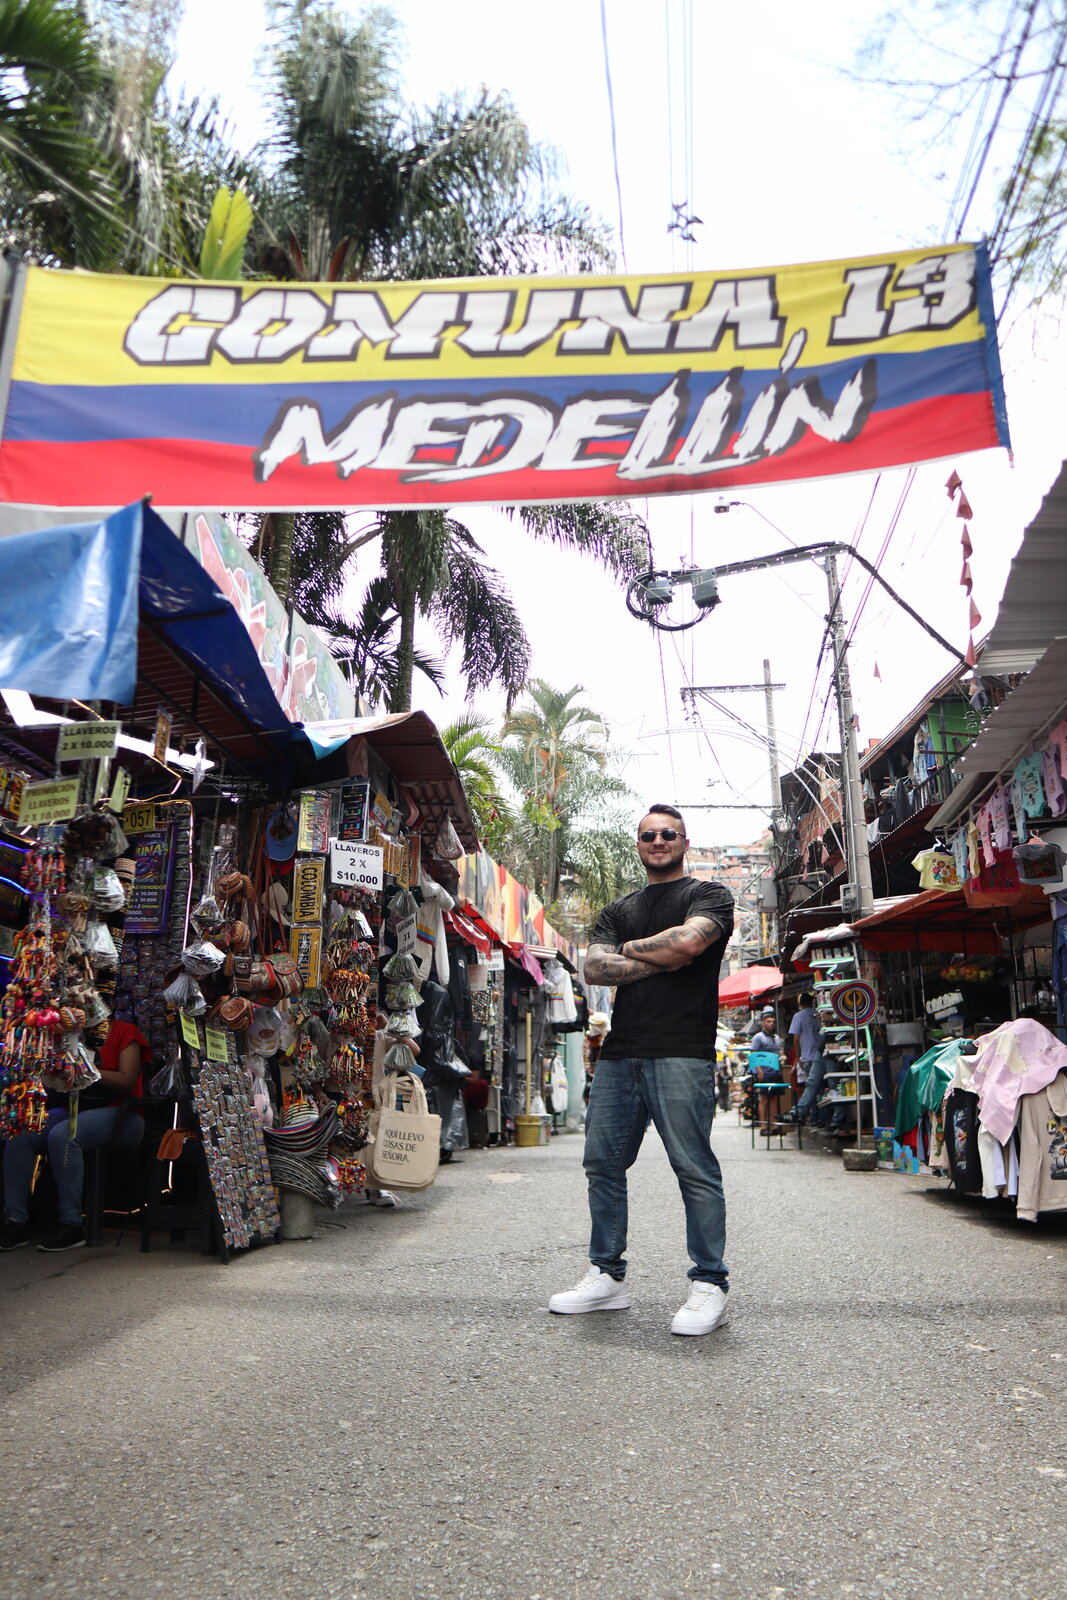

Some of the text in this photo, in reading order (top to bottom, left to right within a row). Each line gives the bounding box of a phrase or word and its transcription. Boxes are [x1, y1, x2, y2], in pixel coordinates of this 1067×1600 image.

[123, 250, 981, 366] COMUNA 13
[64, 726, 117, 736] LLAVEROS
[62, 740, 114, 750] 2 X 10.000
[23, 814, 29, 822] 2
[130, 809, 151, 828] 057
[335, 843, 380, 857] LLAVEROS
[349, 858, 367, 868] 2 X
[336, 870, 378, 885] $10.000
[299, 867, 318, 918] COLOMBIA
[398, 1131, 425, 1142] LLEVO
[383, 1138, 417, 1152] COSAS DE
